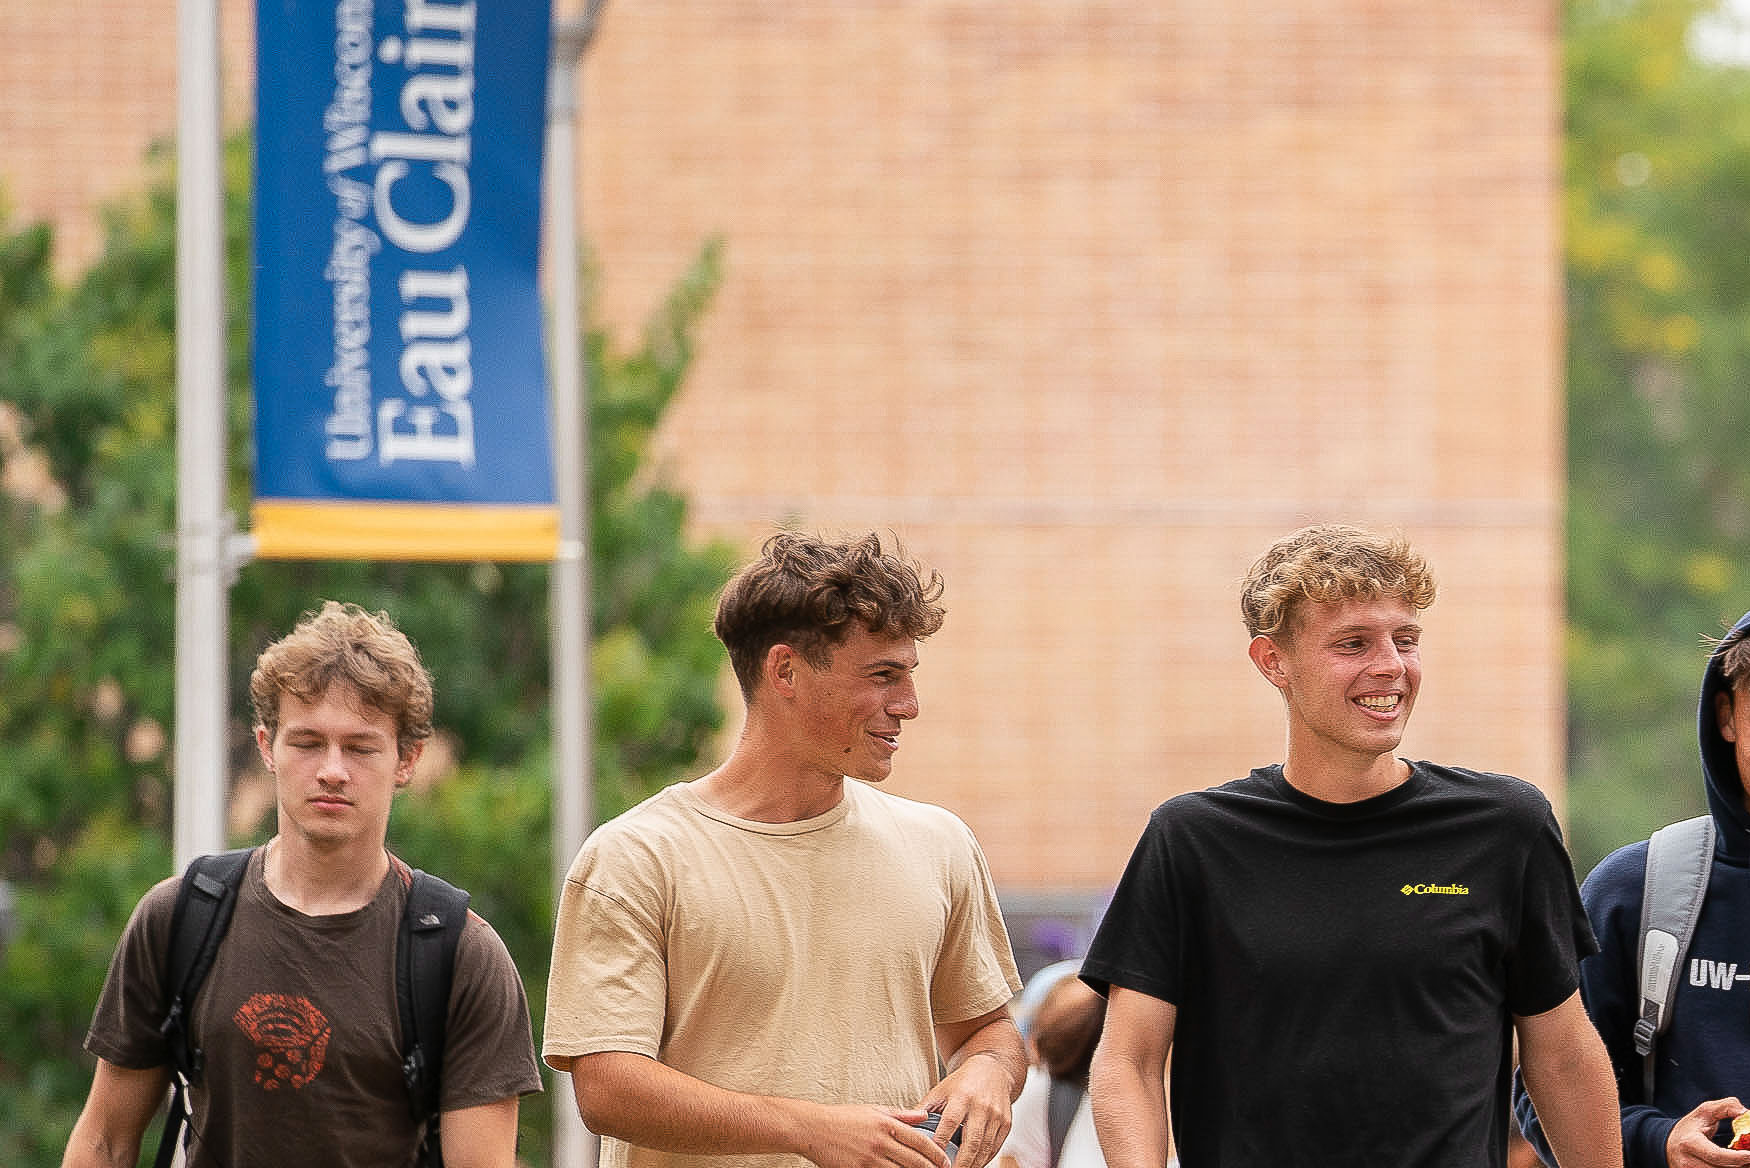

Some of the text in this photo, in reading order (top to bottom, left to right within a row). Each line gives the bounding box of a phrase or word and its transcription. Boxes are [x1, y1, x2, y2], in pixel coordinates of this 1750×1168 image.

[326, 174, 373, 219] of
[324, 218, 382, 461] University
[377, 264, 476, 467] Eau
[1414, 884, 1469, 895] Columbia
